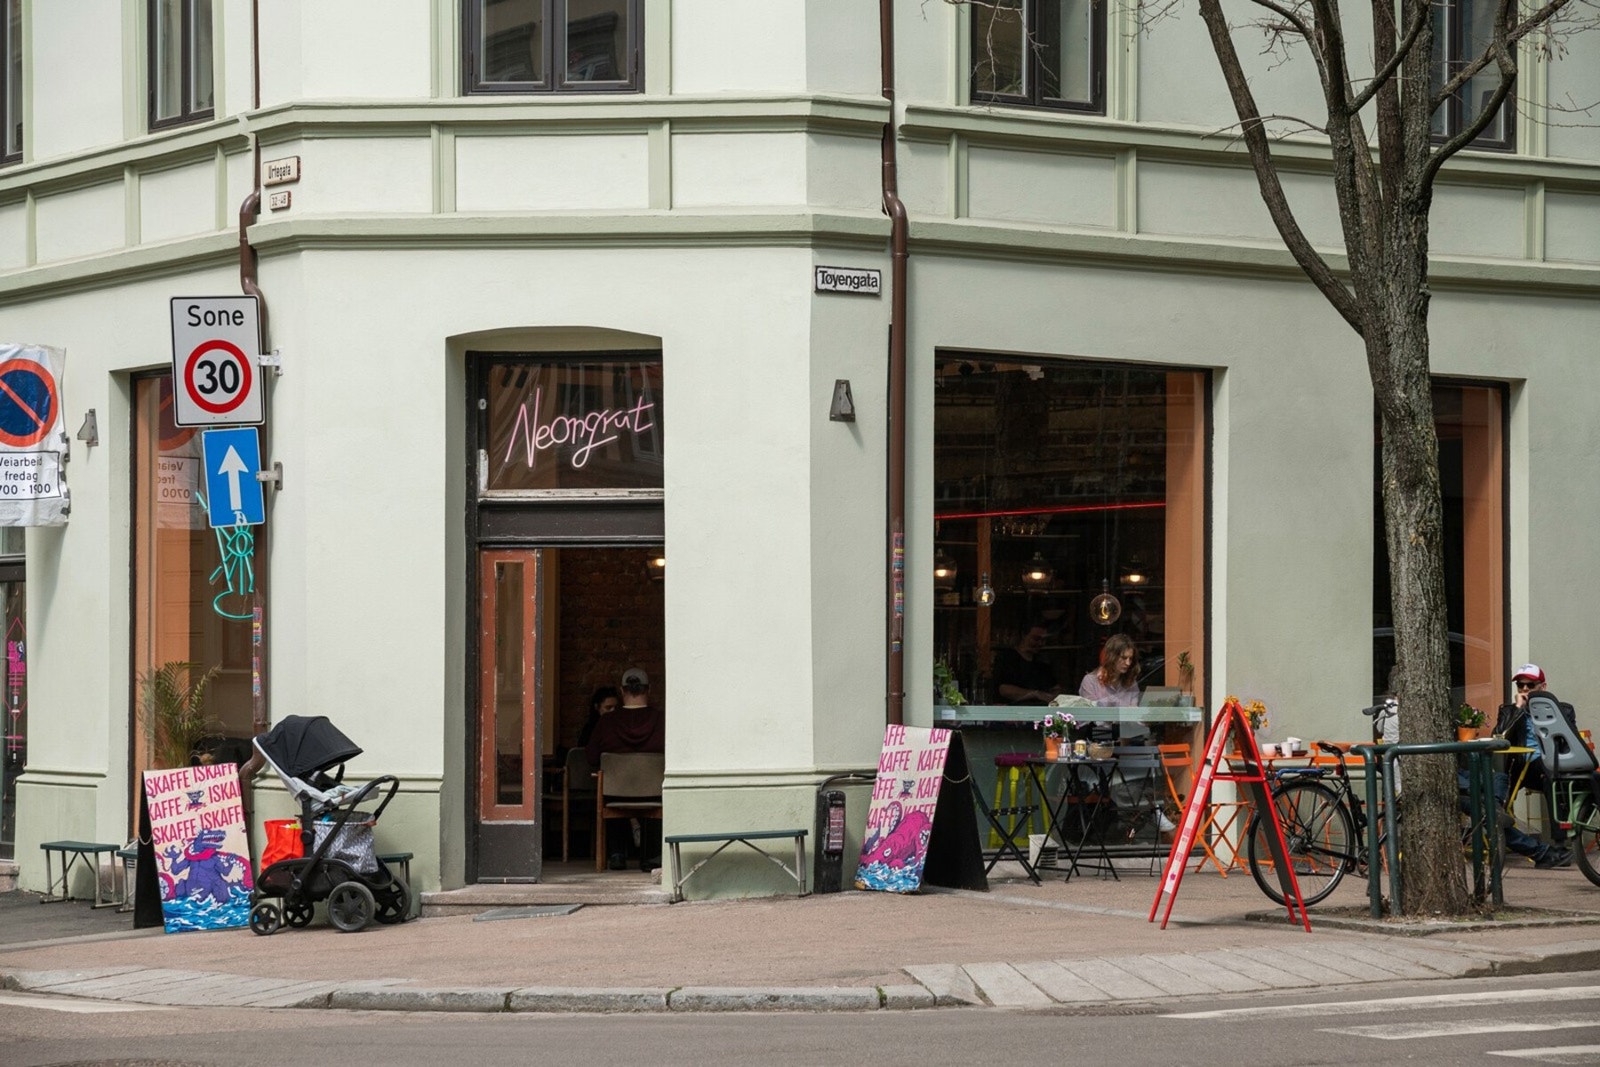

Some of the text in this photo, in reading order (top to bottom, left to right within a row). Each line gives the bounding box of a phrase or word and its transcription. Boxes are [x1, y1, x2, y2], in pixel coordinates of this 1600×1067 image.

[819, 270, 878, 289] Tøyengata
[187, 304, 245, 327] Sone
[197, 359, 240, 394] 30
[505, 387, 655, 469] Neongrut
[5, 471, 38, 483] fredag
[878, 750, 912, 773] KAFFE
[146, 763, 238, 797] SKAFFE ISKAFF
[152, 818, 197, 845] SKAFFE
